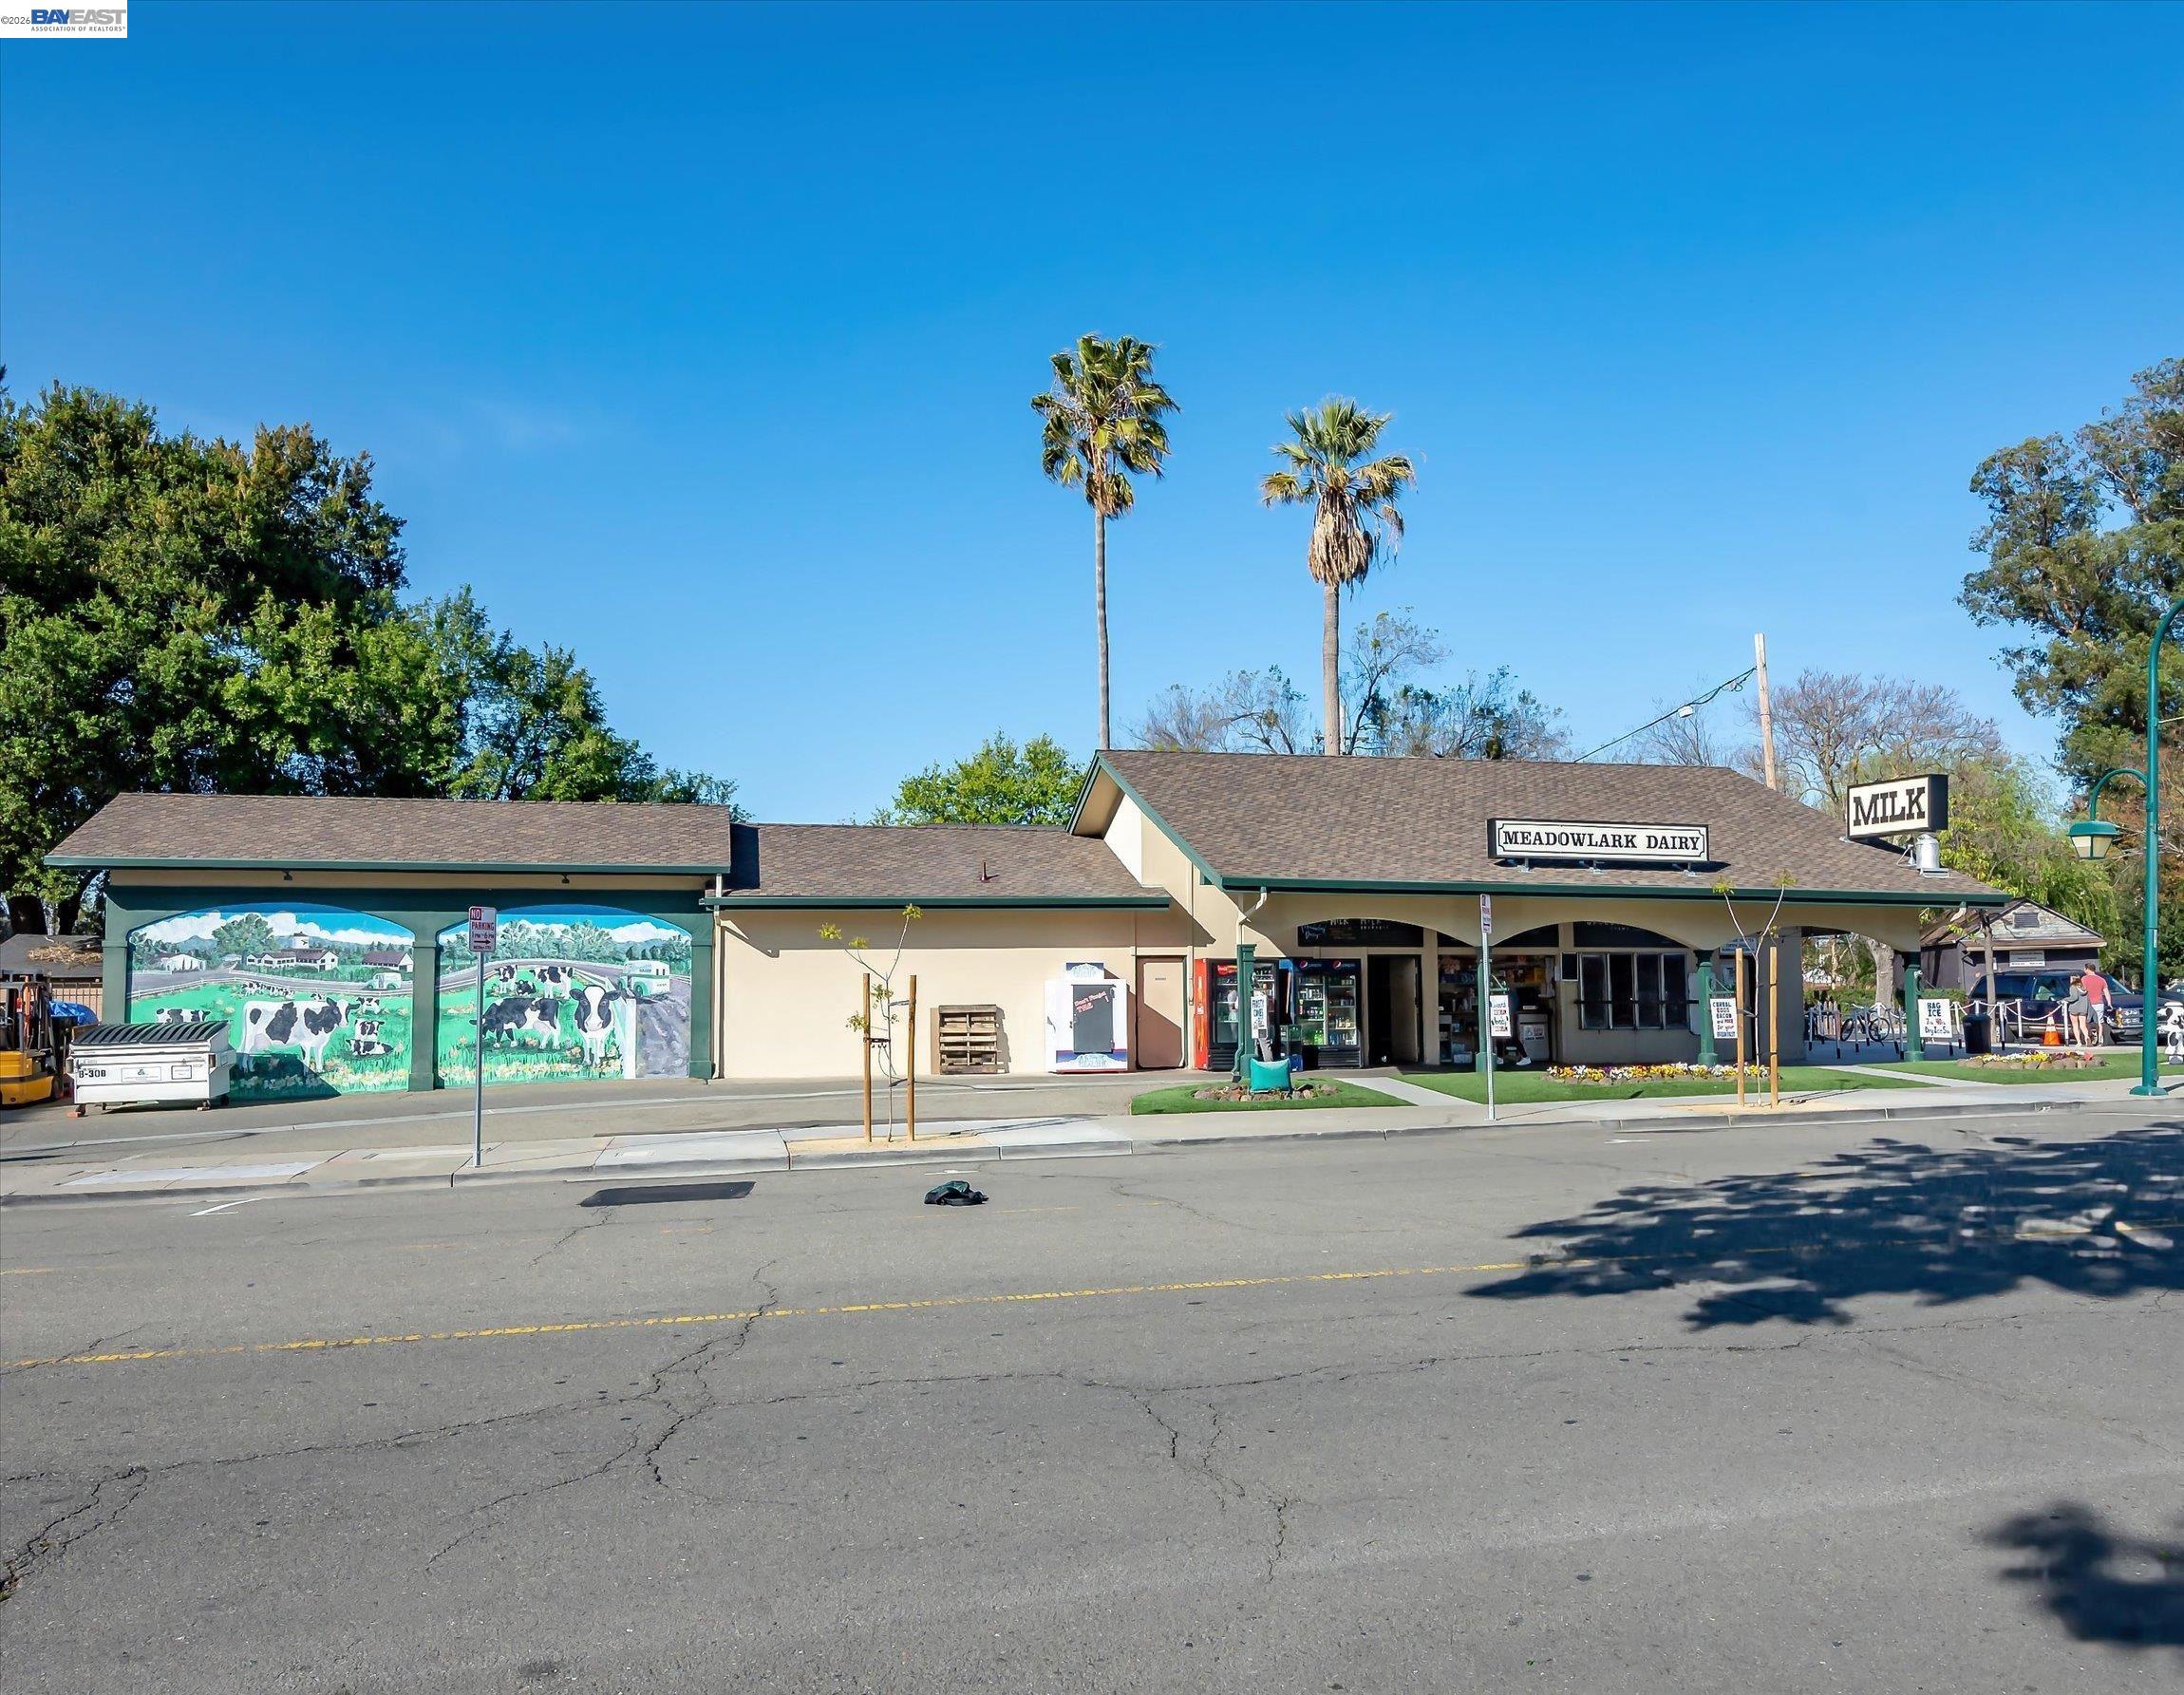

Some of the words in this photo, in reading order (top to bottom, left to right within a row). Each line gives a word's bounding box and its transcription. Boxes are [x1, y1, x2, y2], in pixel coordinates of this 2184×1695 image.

[1853, 786, 1926, 826] MILK
[1502, 831, 1637, 849] MEADOWLARK
[1646, 835, 1700, 851] DAIRY
[471, 909, 480, 920] NO
[472, 922, 495, 931] PARKING
